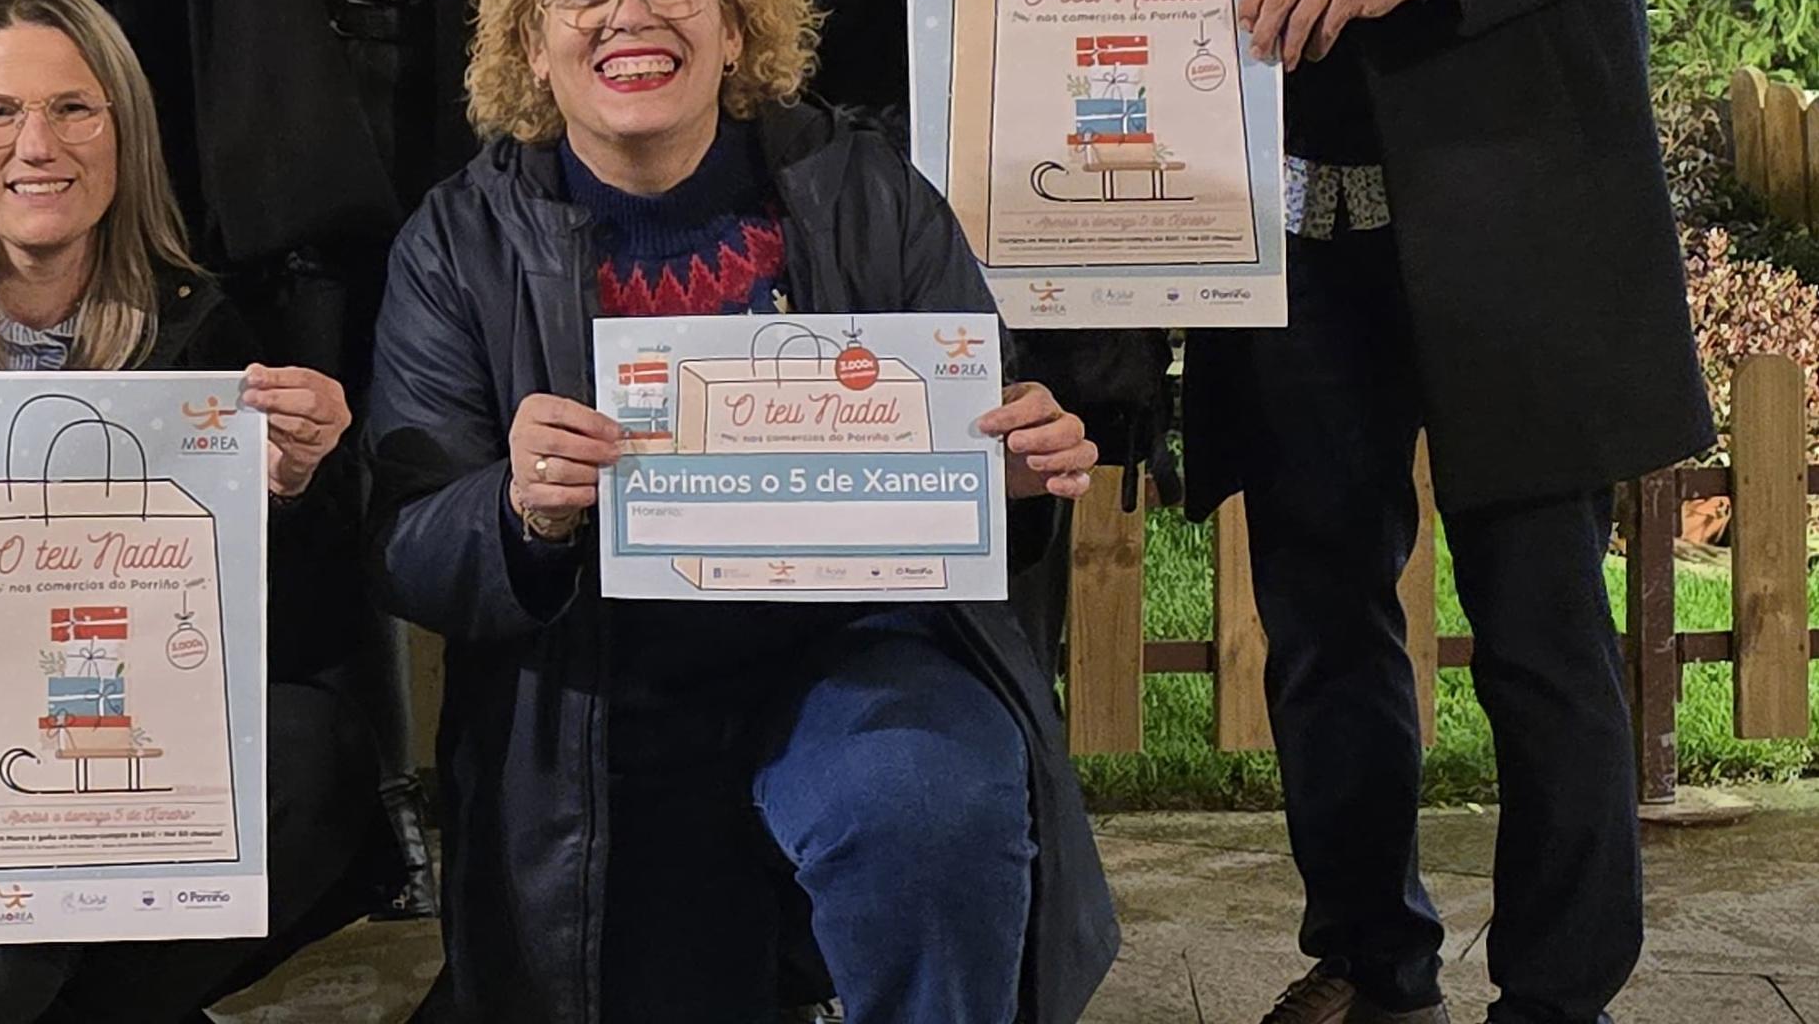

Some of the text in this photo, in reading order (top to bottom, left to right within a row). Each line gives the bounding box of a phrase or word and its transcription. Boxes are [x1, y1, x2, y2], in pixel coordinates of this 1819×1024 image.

[1036, 9, 1197, 23] nos comercios do Porriño
[934, 363, 987, 376] MOREA
[723, 392, 901, 432] O teu Nadal
[182, 437, 238, 450] MOREA
[625, 468, 979, 495] Abrimos o 5 de Xaneiro
[35, 539, 81, 568] teu
[87, 531, 194, 577] Nadal
[9, 577, 180, 593] nos comercios do Porriño
[177, 890, 230, 903] O Porriño
